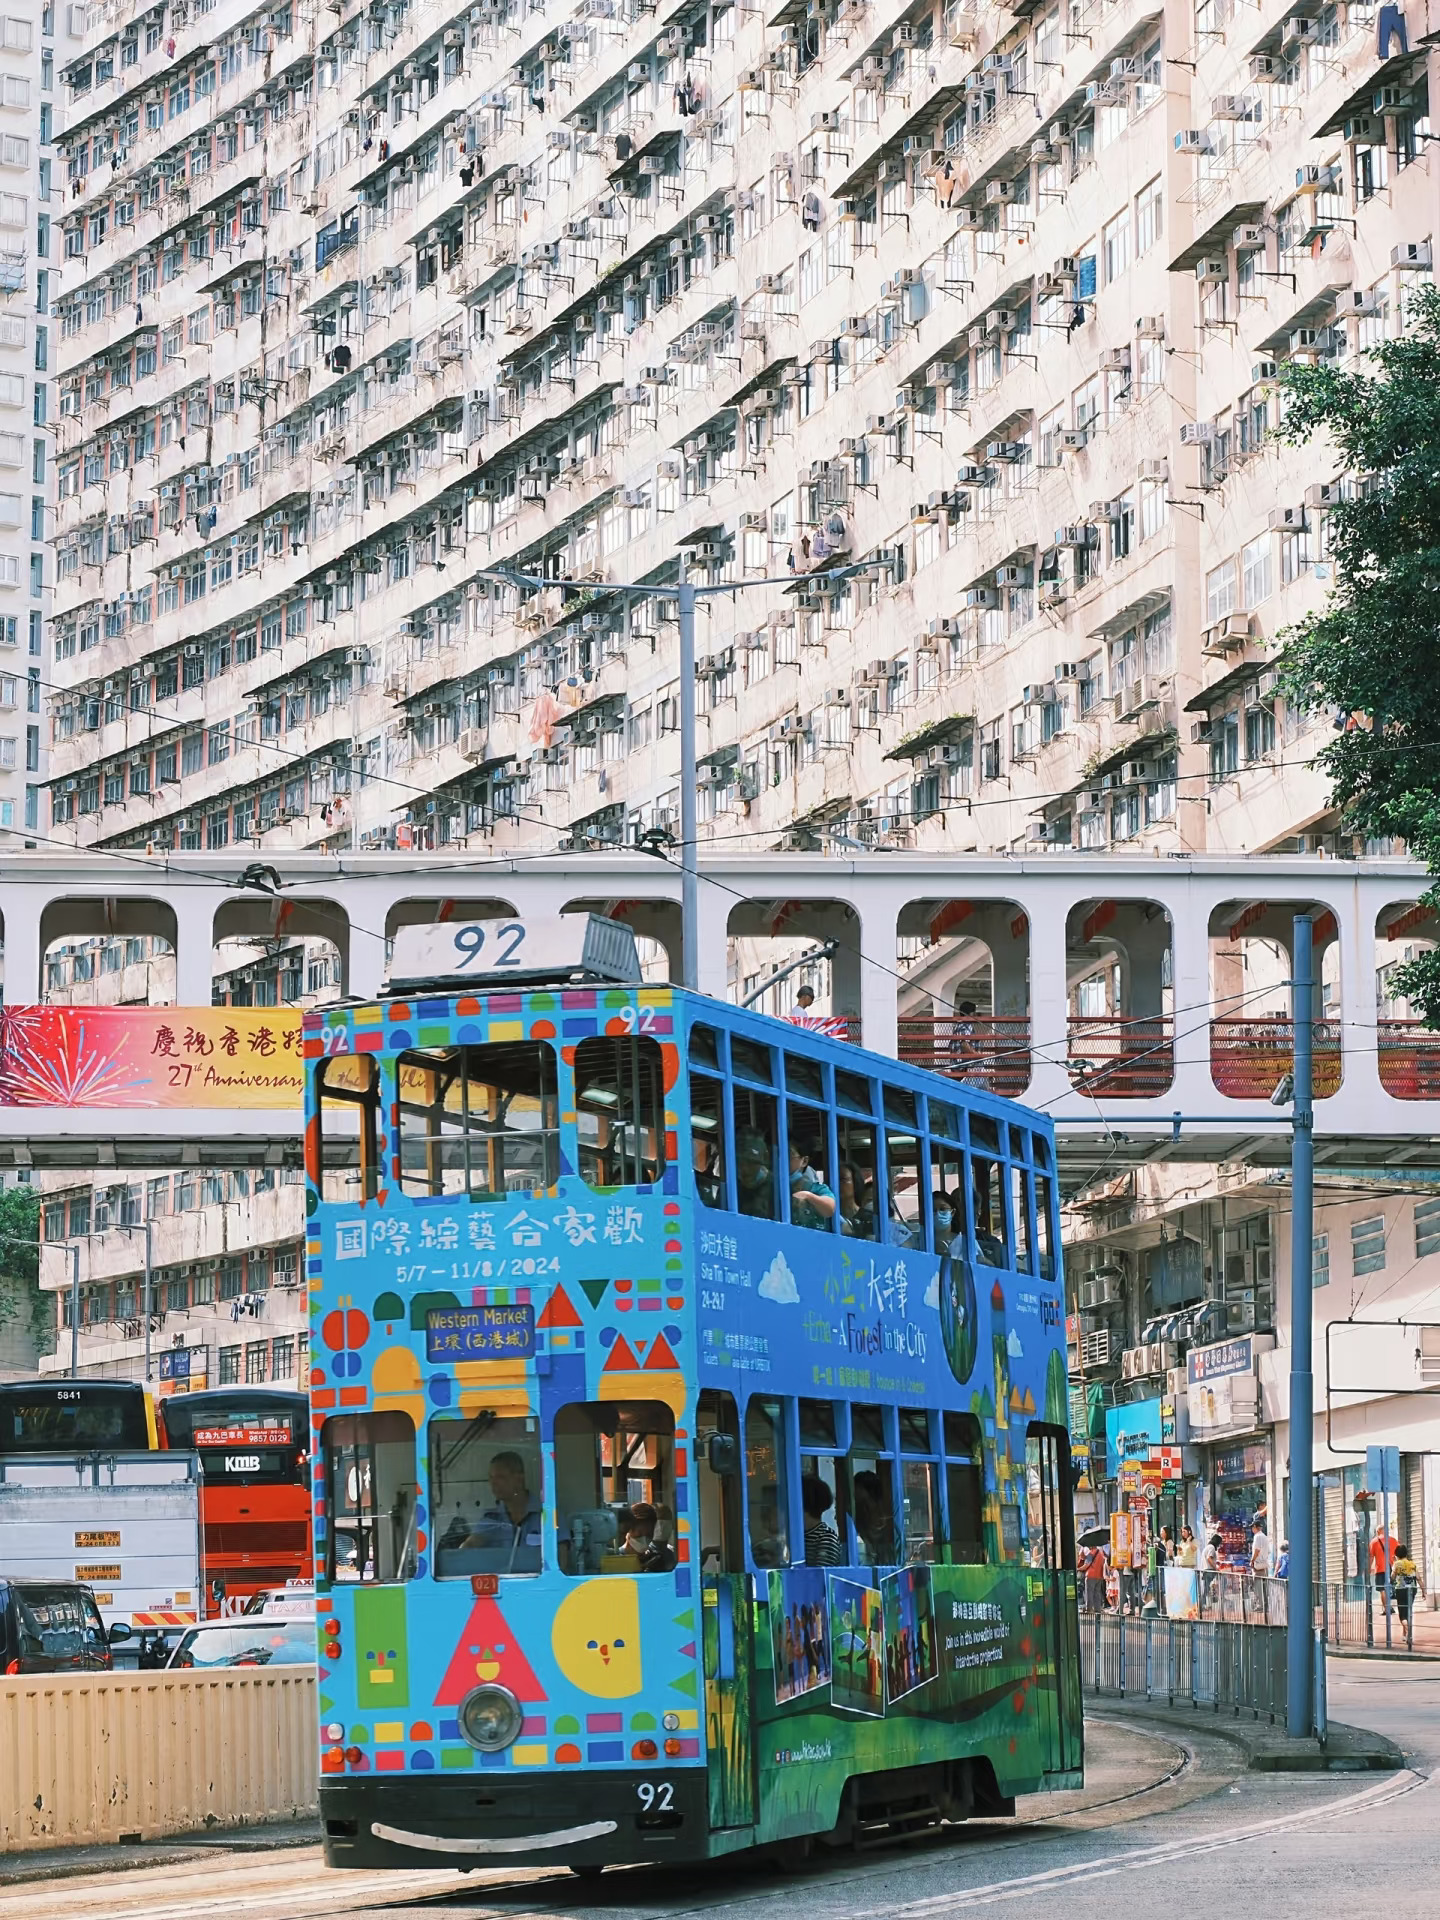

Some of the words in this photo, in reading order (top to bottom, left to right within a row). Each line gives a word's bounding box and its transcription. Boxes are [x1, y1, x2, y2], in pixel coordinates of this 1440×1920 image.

[454, 924, 526, 969] 92
[619, 1005, 656, 1033] 92
[320, 1024, 348, 1053] 92
[168, 1063, 203, 1087] 27th
[336, 1206, 644, 1260] 國際綜藝合家歡
[396, 1265, 426, 1283] 5/7
[429, 1312, 480, 1329] Western
[484, 1308, 529, 1326] Market
[847, 1312, 884, 1356] Forest
[893, 1328, 906, 1354] the
[906, 1322, 928, 1364] City
[57, 1391, 81, 1400] 5841
[197, 1430, 244, 1441] 成為九巴車長
[248, 1434, 267, 1443] 9857
[269, 1434, 288, 1442] 0129
[225, 1456, 260, 1472] KMB
[1163, 1459, 1169, 1467] R
[475, 1577, 497, 1590] 021
[268, 1601, 311, 1613] TAXI
[636, 1782, 675, 1812] 92
